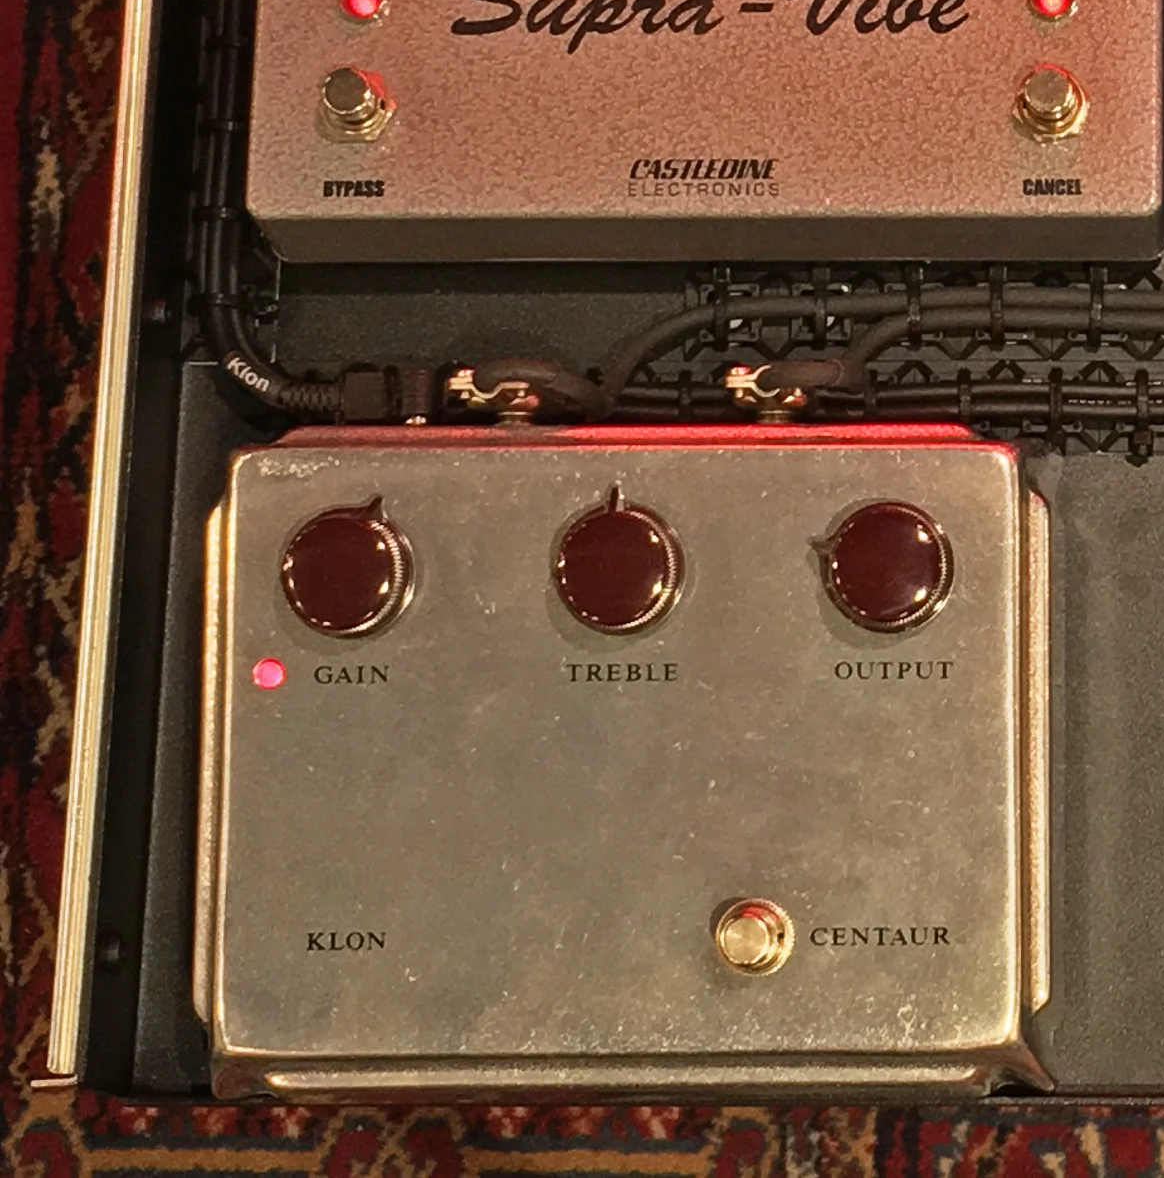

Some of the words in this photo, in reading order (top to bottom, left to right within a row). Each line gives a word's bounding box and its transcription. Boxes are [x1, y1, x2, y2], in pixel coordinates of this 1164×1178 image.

[629, 158, 779, 180] CASTLEDINE
[322, 179, 385, 198] BYPASS
[627, 182, 780, 198] ELECTRONICS
[1022, 178, 1083, 196] CANCEL
[226, 357, 270, 392] Klon
[313, 665, 390, 685] GAIN
[565, 663, 679, 683] TREBLE
[834, 661, 954, 681] OUTPUT
[306, 931, 387, 951] KLON
[809, 926, 951, 946] CENTAUR
